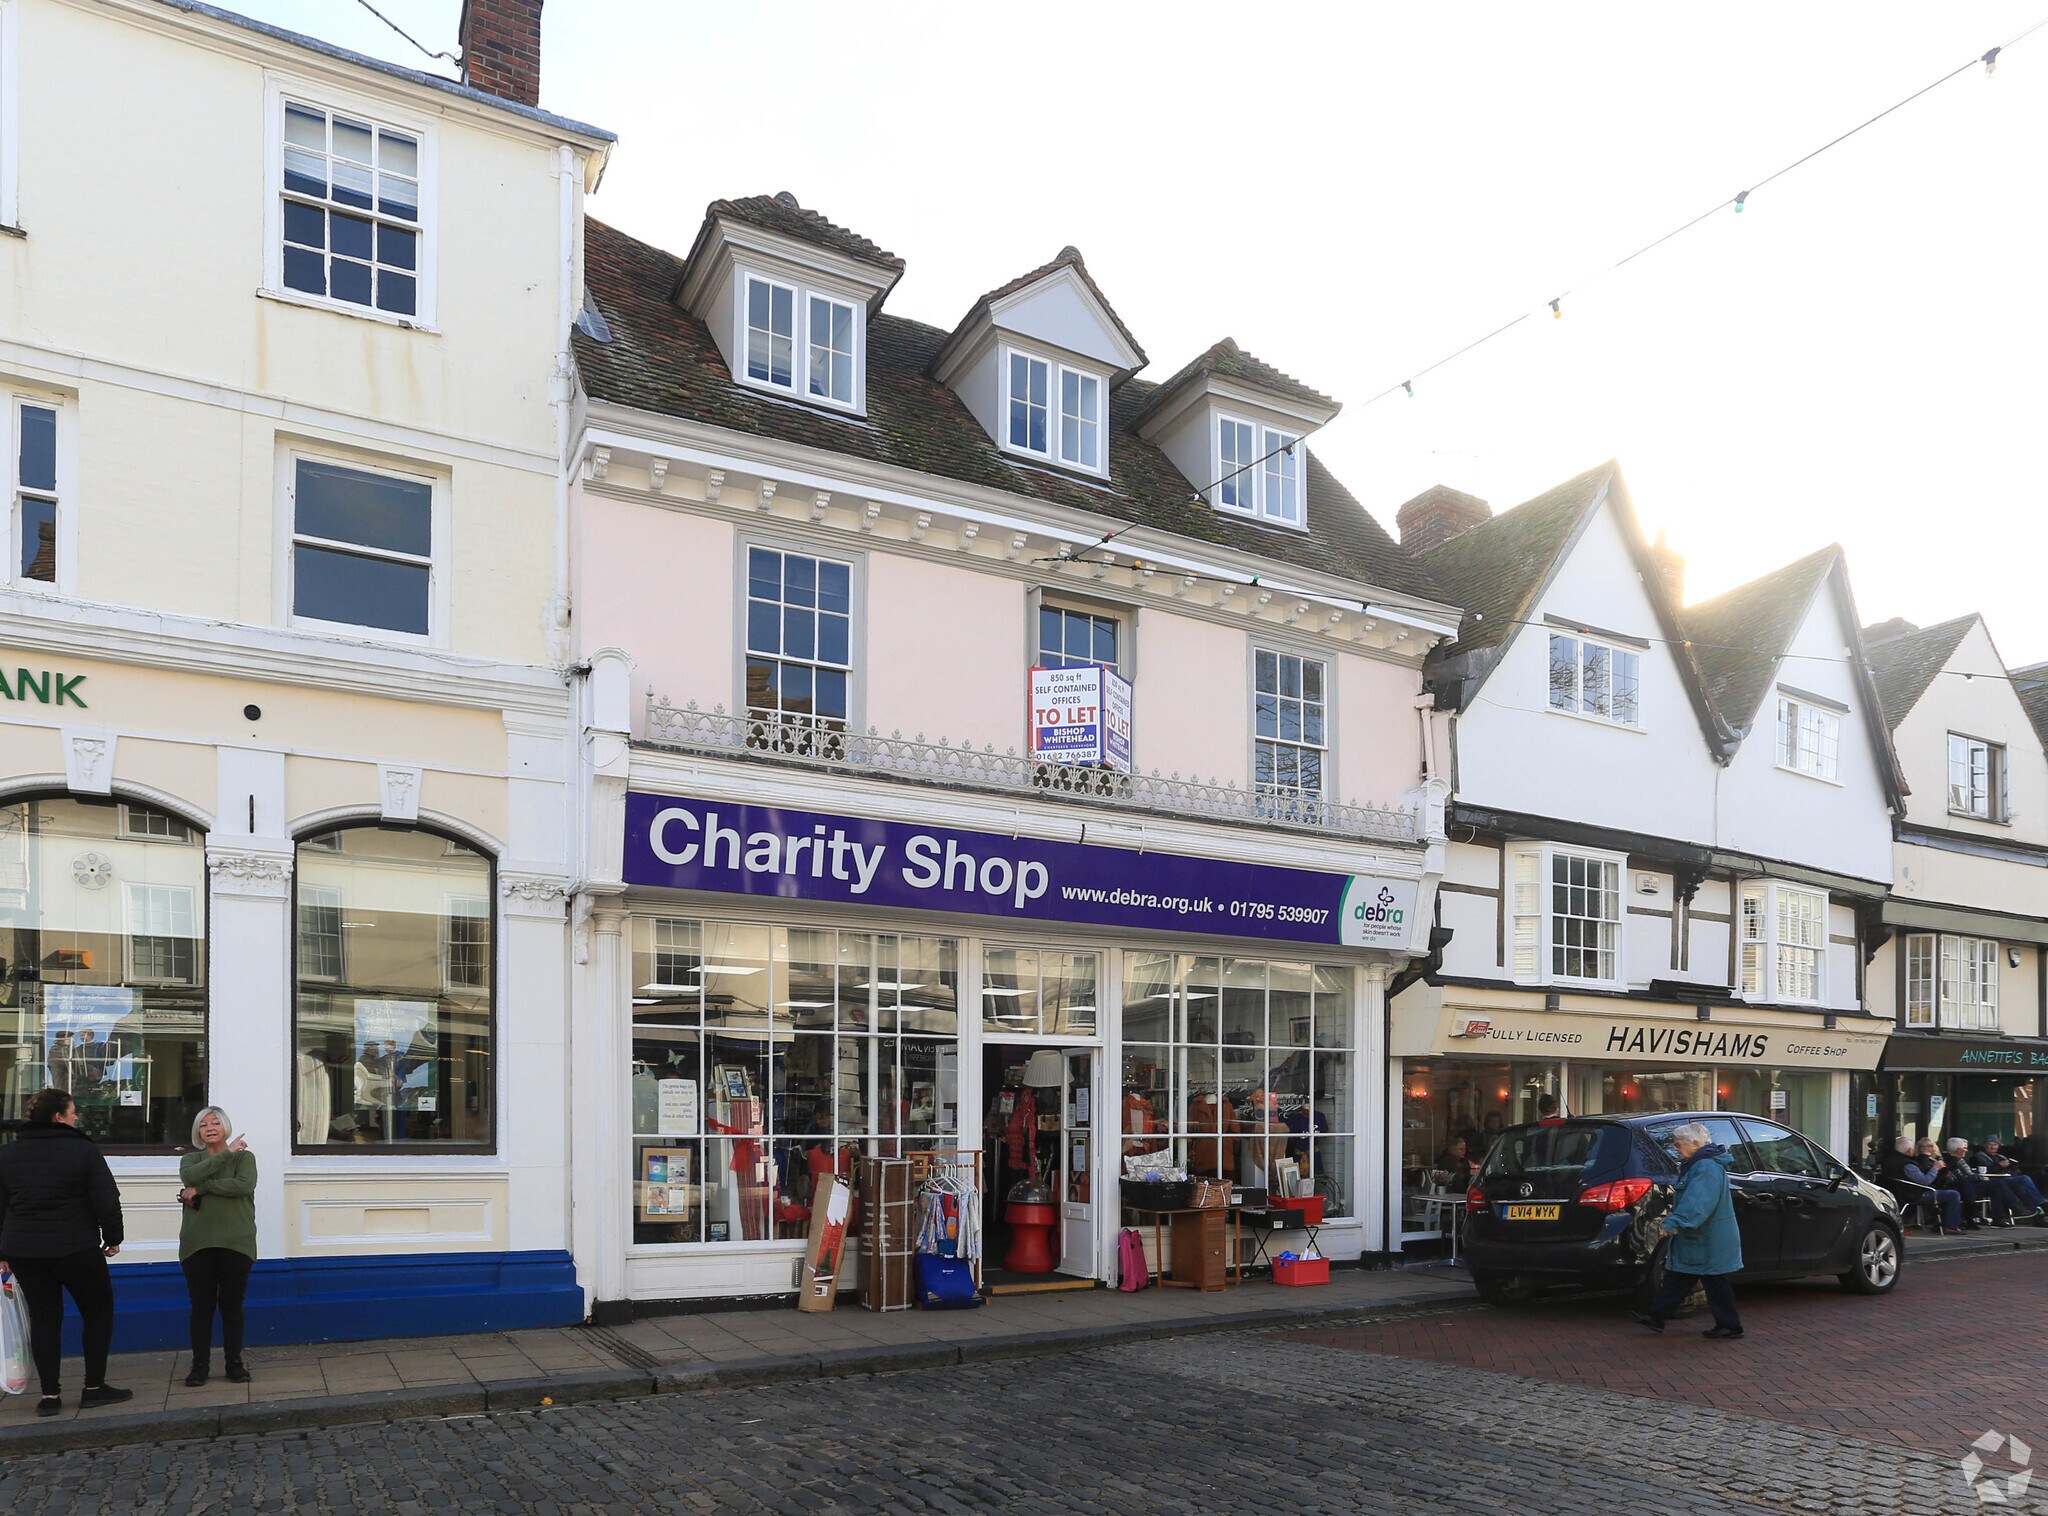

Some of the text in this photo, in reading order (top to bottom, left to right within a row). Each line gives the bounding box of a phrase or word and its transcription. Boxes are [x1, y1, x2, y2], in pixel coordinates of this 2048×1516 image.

[1050, 672, 1082, 683] 850 sq ft
[1035, 683, 1097, 695] SELF CONTAINED
[1051, 695, 1081, 705] OFFICES
[1036, 706, 1097, 725] TO LET
[1106, 709, 1129, 738] TO LET
[1043, 734, 1095, 744] WHITEHEAD
[1053, 727, 1086, 736] BISHOP
[649, 807, 1049, 909] Charity Shop
[1061, 885, 1329, 925] www.debra.org.uk 01795 539907
[1354, 901, 1404, 924] debra
[1484, 1027, 1524, 1040] FULLY
[1526, 1029, 1583, 1044] LICENSED
[1605, 1026, 1769, 1058] HAVISHAMS
[1786, 1043, 1848, 1057] COFFEE SHOP
[1959, 1049, 2024, 1064] ANNETTE'S
[1510, 1206, 1555, 1218] LV14 WYK
